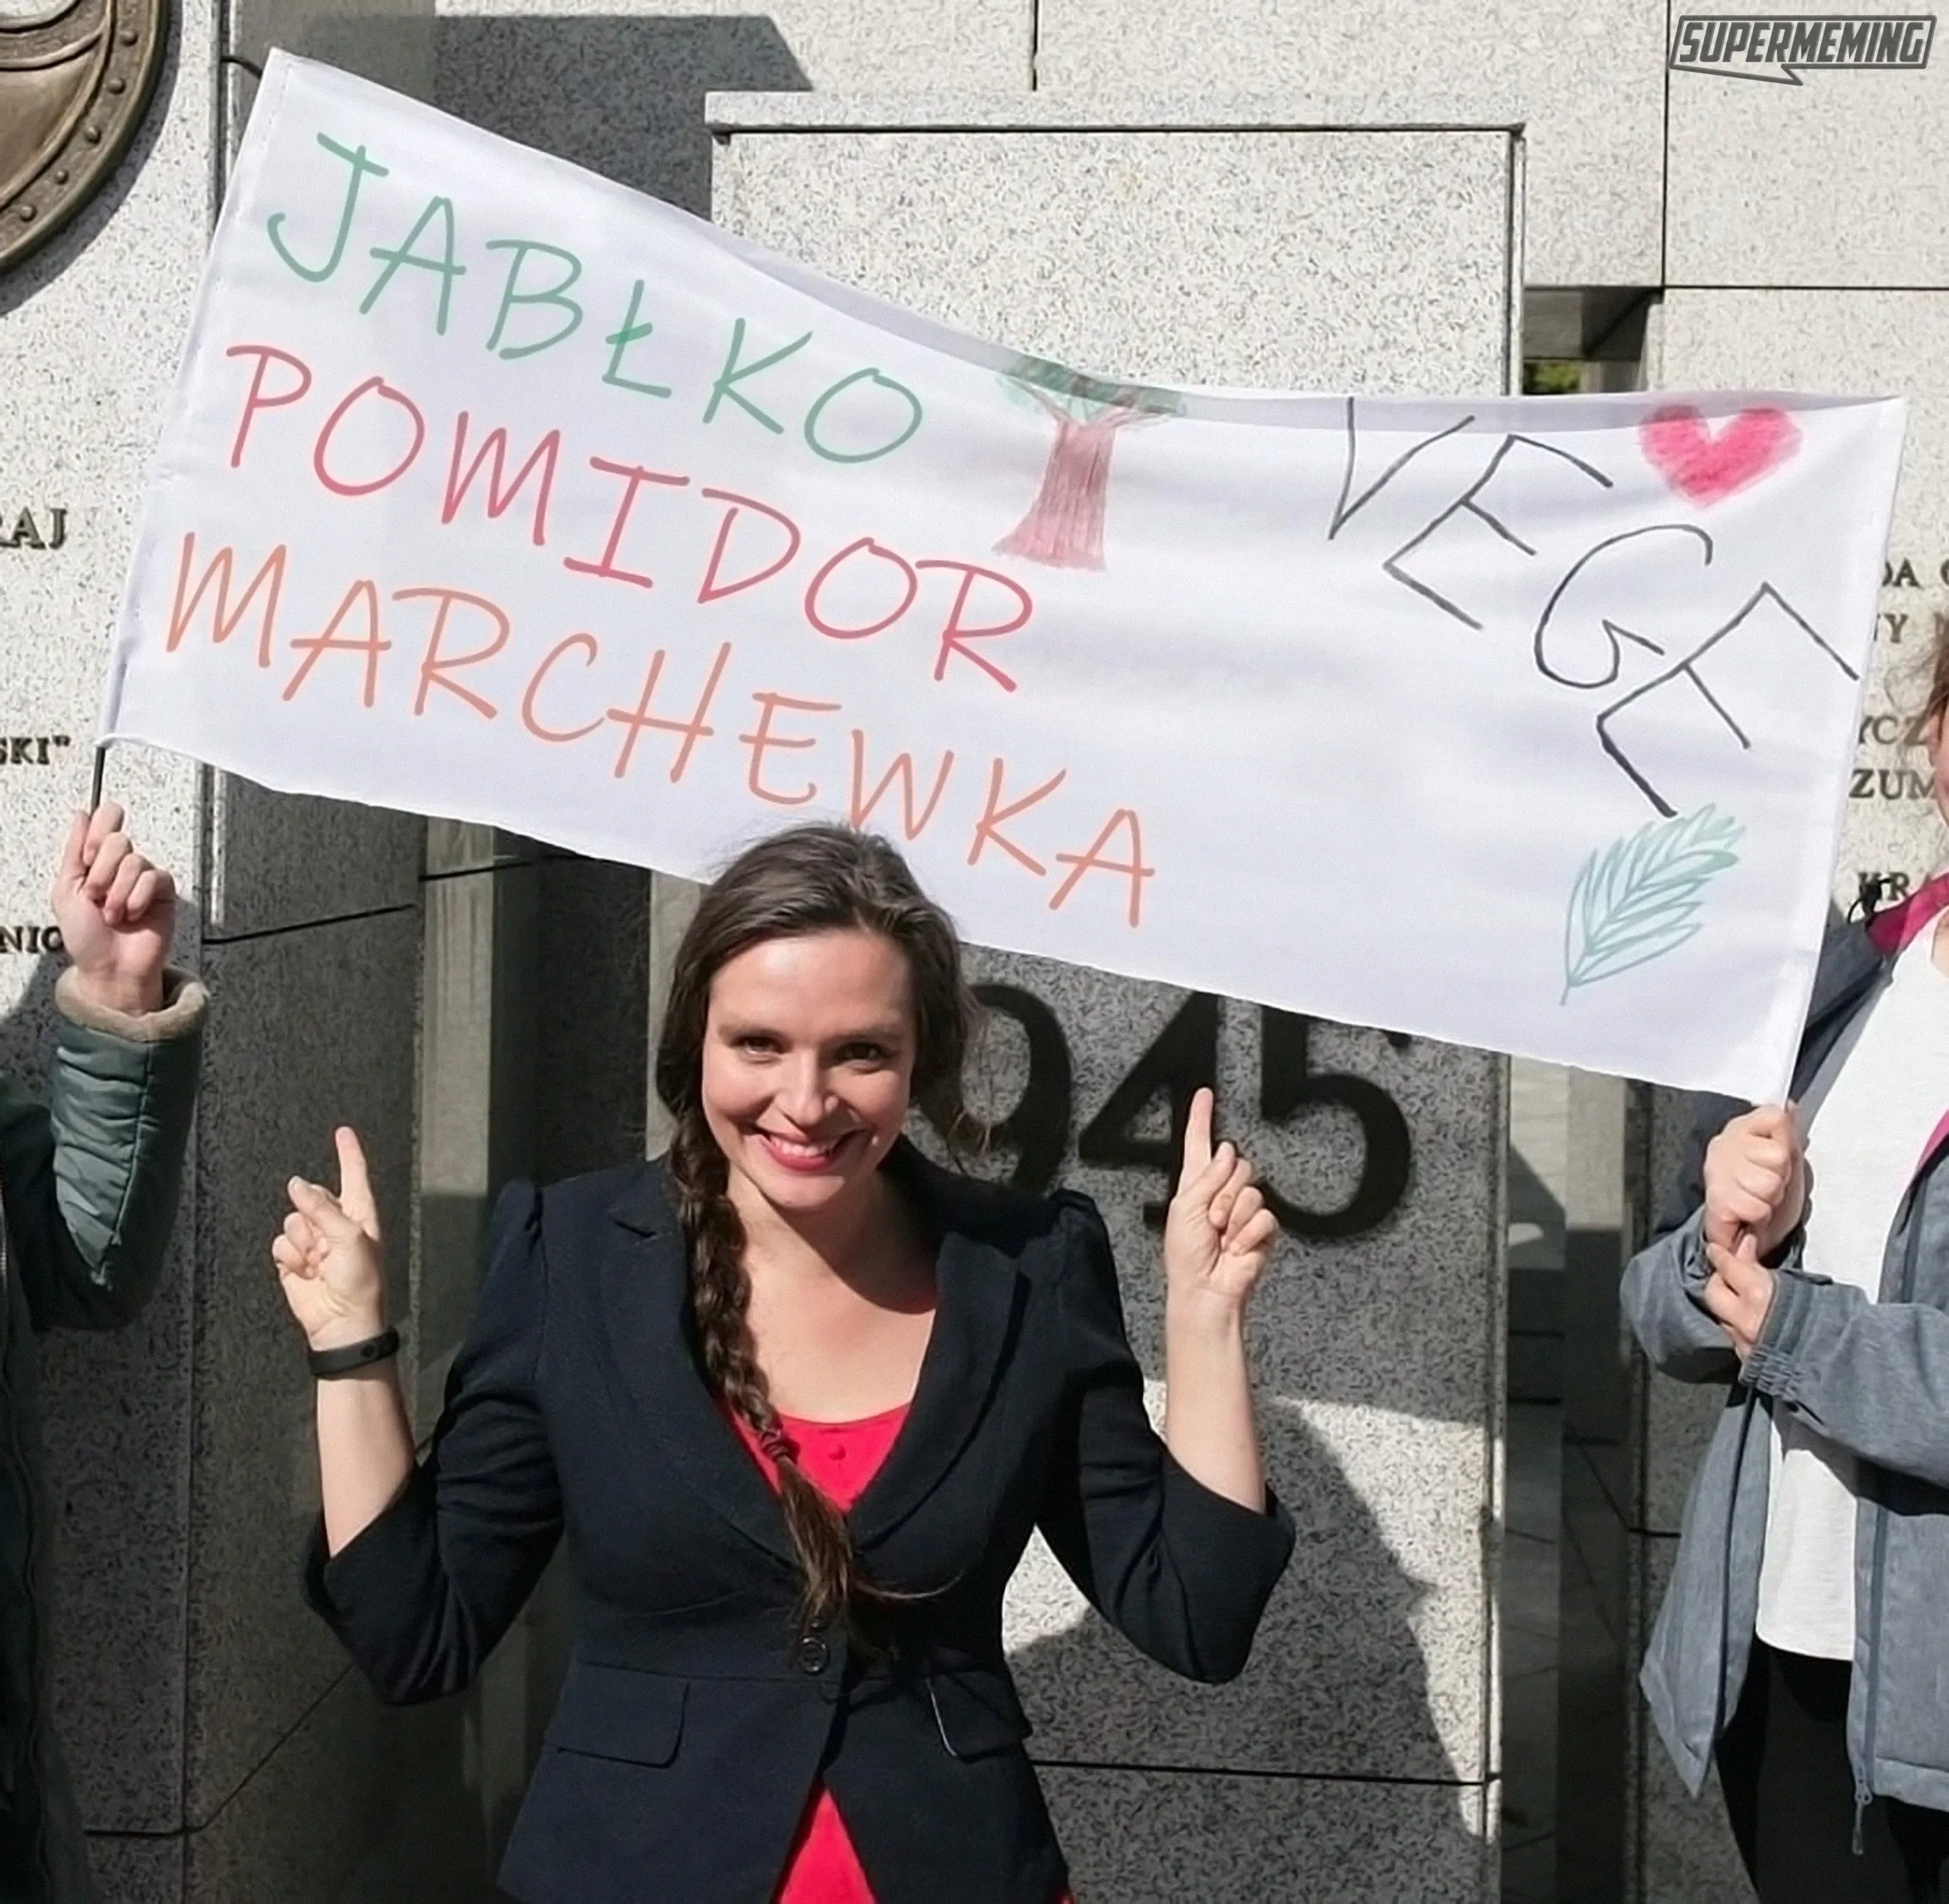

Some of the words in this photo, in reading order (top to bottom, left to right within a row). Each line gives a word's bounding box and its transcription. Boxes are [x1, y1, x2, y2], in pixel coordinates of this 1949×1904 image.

[266, 131, 923, 464] JABŁKO
[0, 507, 68, 550] AJ
[226, 344, 1034, 693] POMIDOR
[1328, 397, 1860, 818] VEGE
[164, 530, 1156, 928] MARCHEWKA
